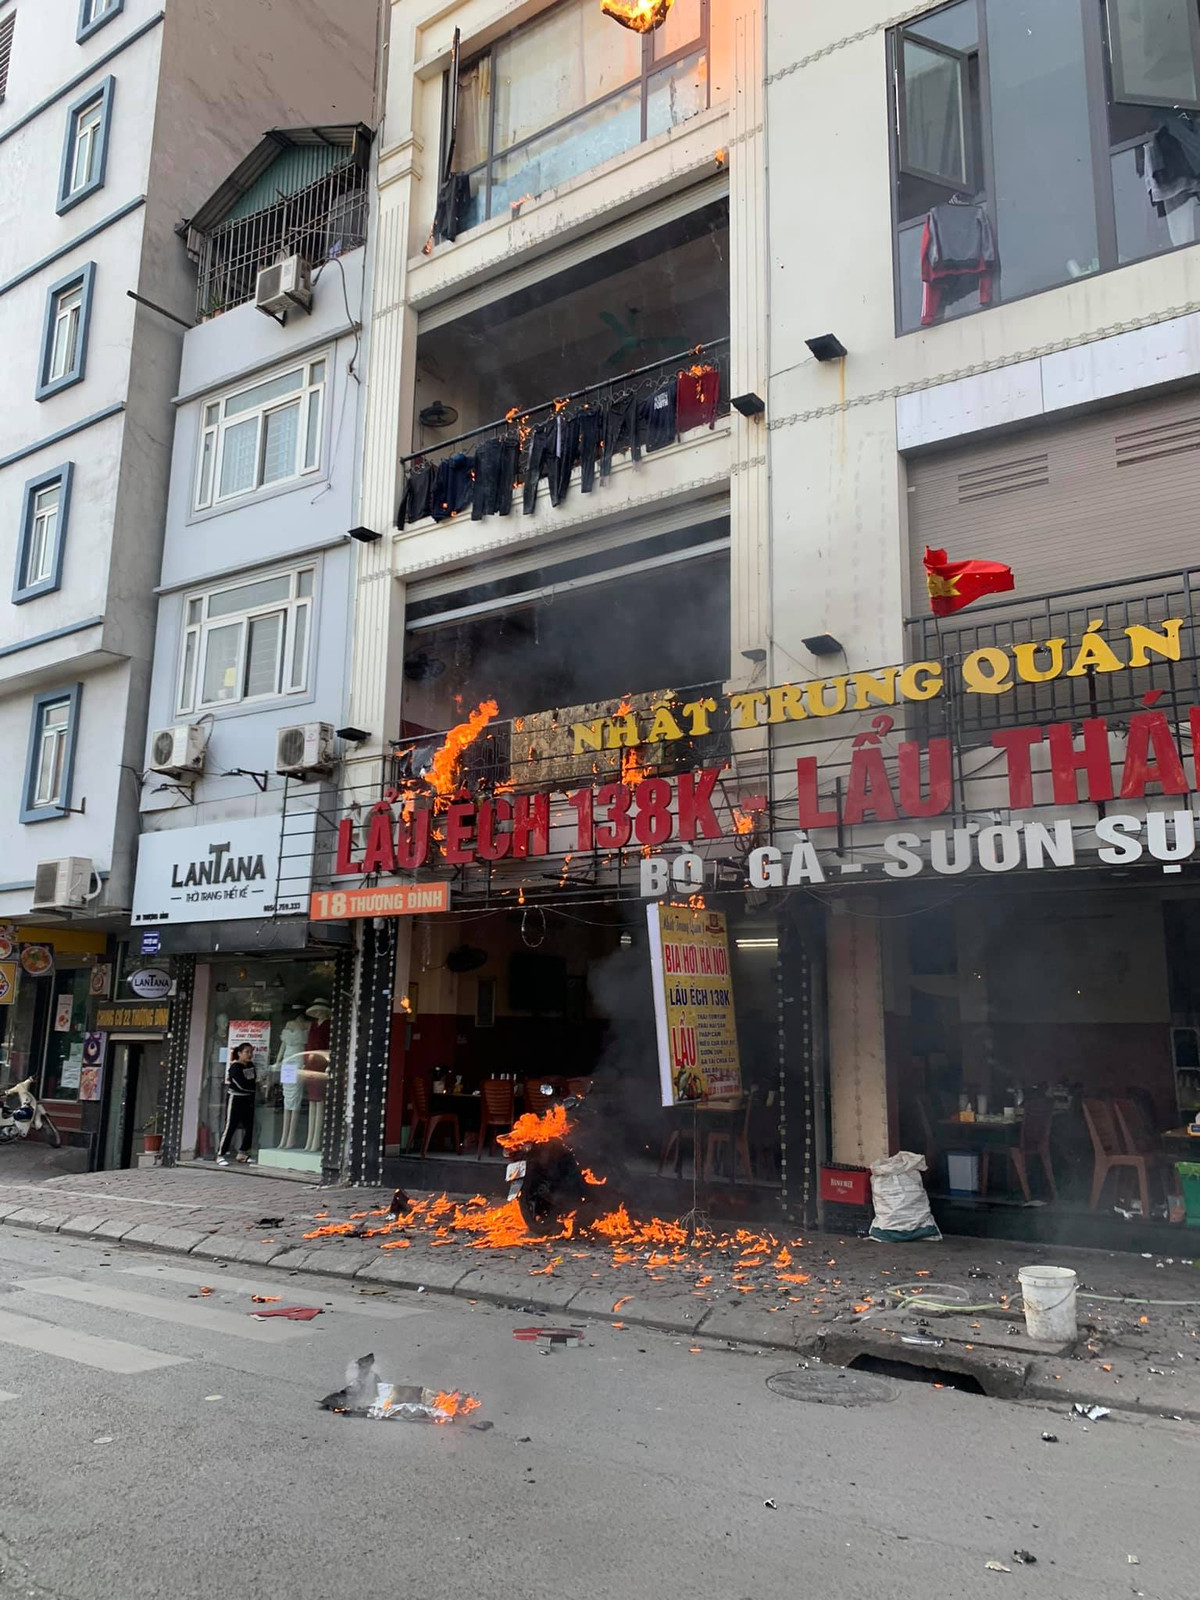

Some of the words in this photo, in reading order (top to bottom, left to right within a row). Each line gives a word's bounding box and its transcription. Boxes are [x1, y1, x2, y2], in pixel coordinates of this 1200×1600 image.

[730, 661, 944, 729] TRUNG
[962, 618, 1184, 694] QUÁN
[336, 787, 432, 875] LẨU
[568, 767, 723, 852] 138K
[797, 714, 954, 829] LẨU
[171, 841, 266, 888] LANTANA
[640, 844, 703, 898] BÒ
[749, 832, 827, 889] GÀ
[884, 812, 1076, 879] SƯỜN
[1095, 809, 1200, 874] SỤ
[201, 890, 223, 902] TRANG
[318, 892, 347, 918] 18
[350, 893, 403, 914] THƯỢNG
[407, 889, 443, 909] ĐÌNH
[134, 974, 169, 987] LANTANA
[664, 944, 682, 974] BIA
[682, 944, 699, 975] HƠI
[699, 940, 713, 975] HÀ
[712, 941, 729, 981] NỘI
[689, 983, 709, 1006] ẾCH
[710, 989, 731, 1006] 138K
[672, 1010, 696, 1068] LẨU
